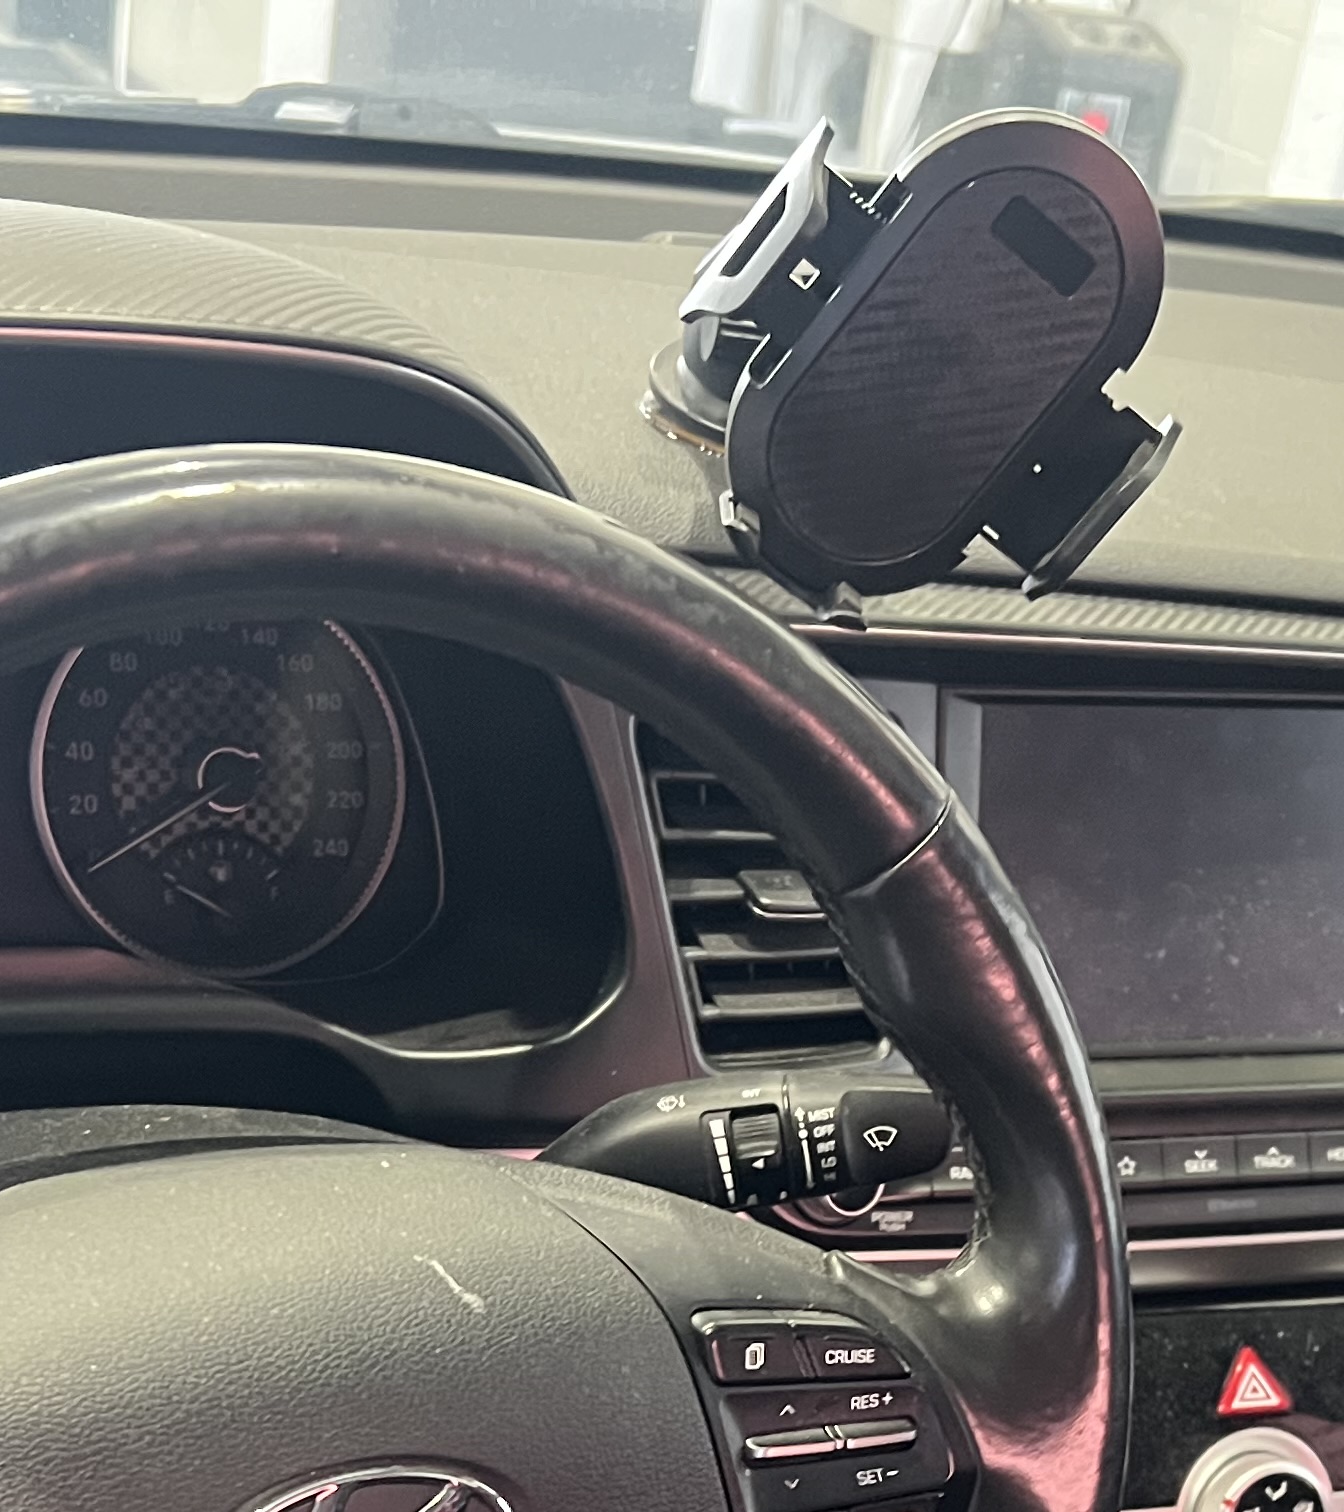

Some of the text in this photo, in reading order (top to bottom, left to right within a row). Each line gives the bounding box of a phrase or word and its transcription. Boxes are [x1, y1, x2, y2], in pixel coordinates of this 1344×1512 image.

[240, 626, 280, 647] 140
[109, 651, 138, 673] 80
[276, 653, 314, 673] 160
[79, 687, 108, 708] 60
[303, 692, 342, 713] 180
[64, 741, 94, 762] 40
[327, 740, 363, 760] 200
[69, 793, 98, 815] 20
[327, 790, 364, 809] 220
[313, 839, 349, 859] 240
[824, 1347, 876, 1365] CRUISE
